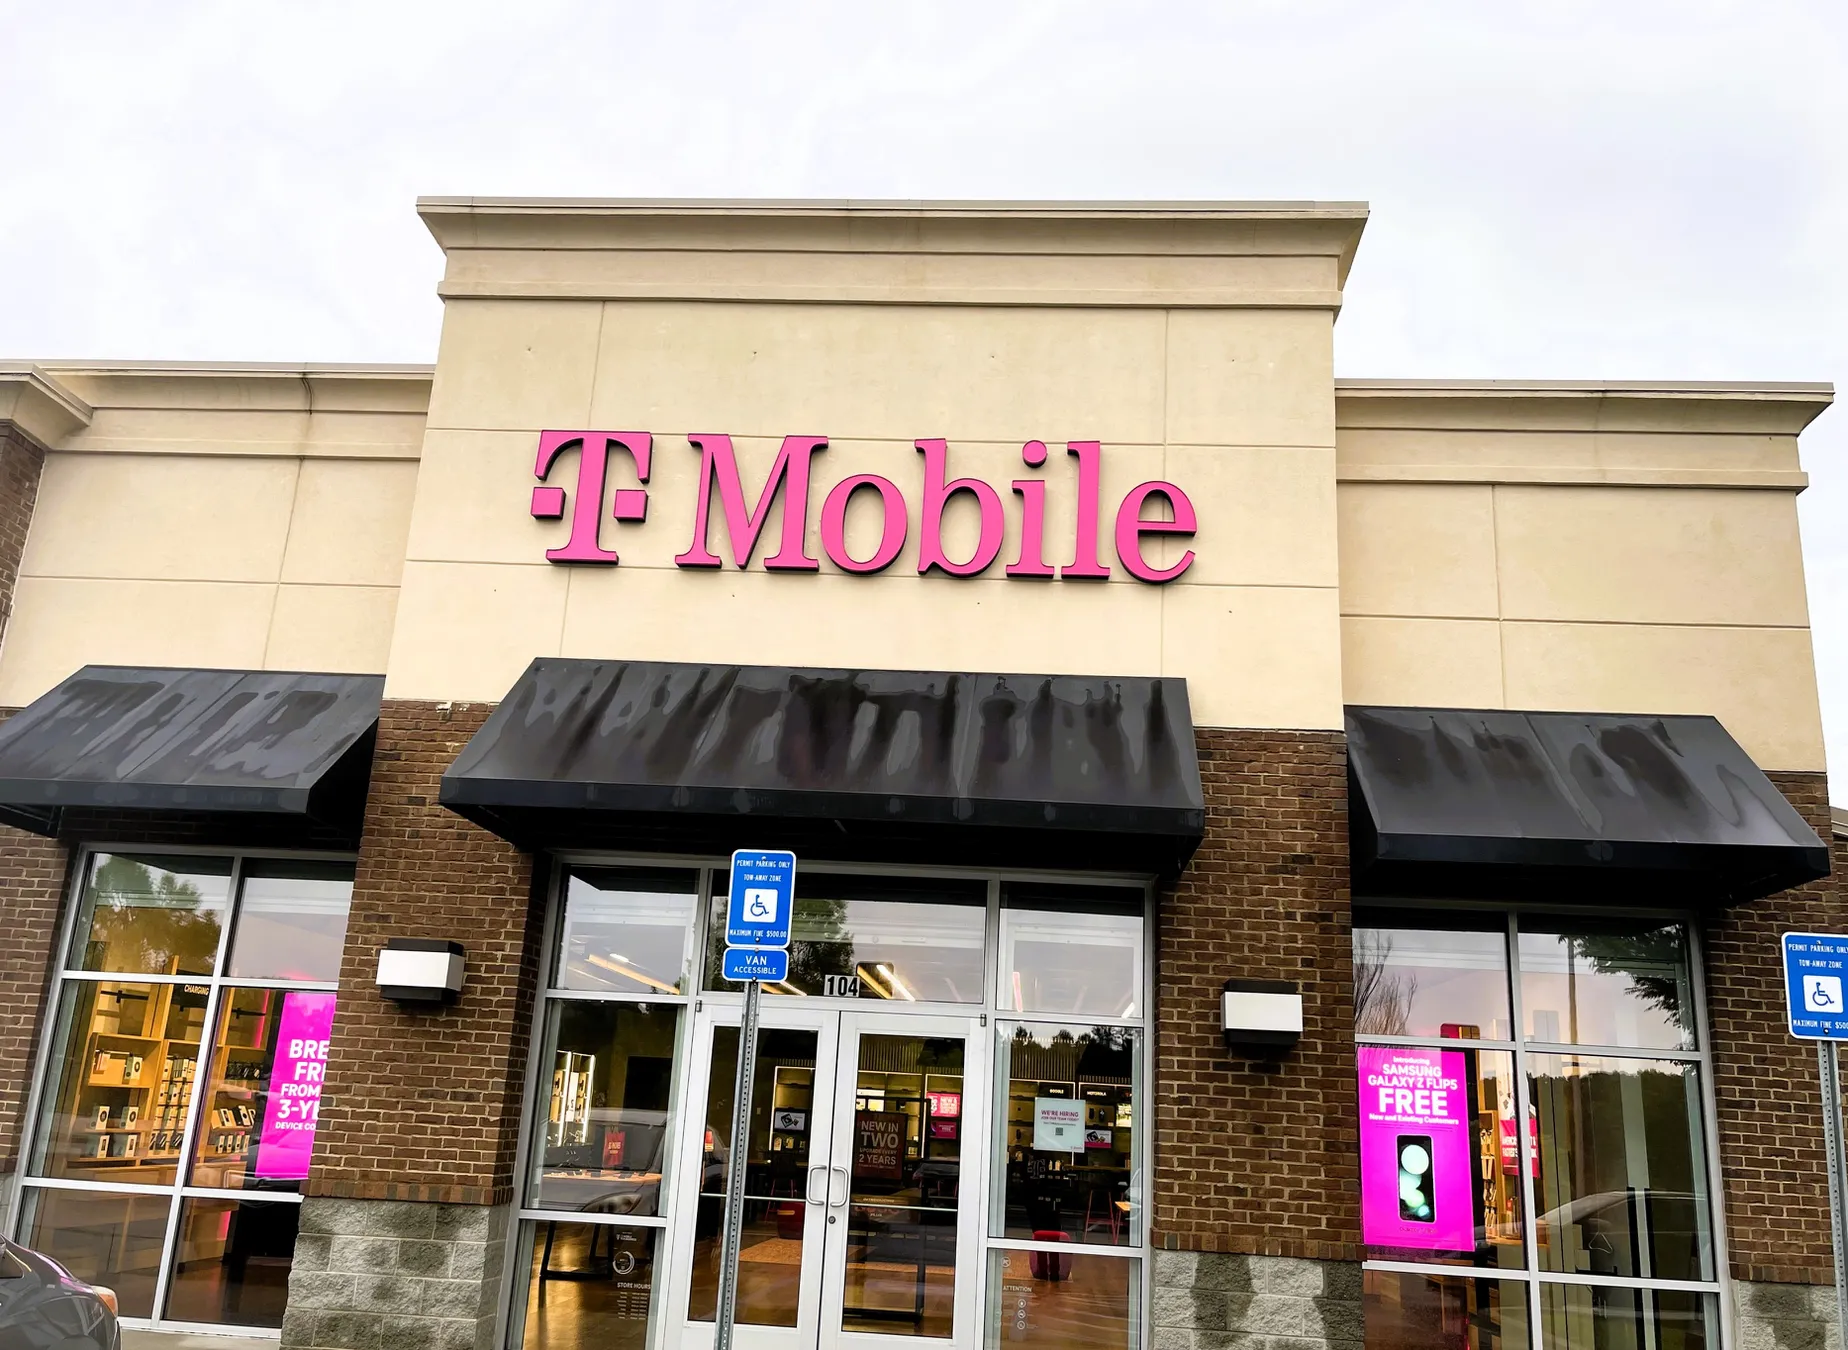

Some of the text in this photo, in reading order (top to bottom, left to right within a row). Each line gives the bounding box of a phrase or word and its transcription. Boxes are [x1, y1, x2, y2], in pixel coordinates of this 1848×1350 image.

[674, 434, 1198, 586] Mobile
[737, 859, 753, 867] PERMIT
[756, 860, 777, 868] PARKING
[743, 874, 768, 882] TOW-AWAY
[729, 929, 752, 937] MAXIMUM
[766, 930, 787, 938] $500.00
[1788, 943, 1807, 952] PERMIT
[1810, 944, 1834, 953] PARKING
[733, 955, 777, 975] VAN ACCESSIBLE
[1799, 959, 1843, 968] TOW-AWAY ZONE
[184, 984, 210, 996] CHARGING
[827, 976, 858, 997] 104
[1792, 1019, 1818, 1028] MAXIMUM
[1820, 1020, 1832, 1029] FINE
[1393, 1056, 1430, 1066] Introducing
[1382, 1064, 1442, 1077] SAMSUNG
[1368, 1075, 1458, 1090] GALAXY Z FLIP5
[281, 1083, 320, 1097] FROM
[1379, 1087, 1448, 1116] FREE
[1041, 1109, 1079, 1118] WE'RE HIRING
[1369, 1113, 1459, 1125] New and Existing Customers
[275, 1121, 303, 1130] DEVICE
[861, 1120, 899, 1132] NEW IN
[861, 1131, 899, 1149] TWO
[859, 1154, 897, 1165] 2 YEARS
